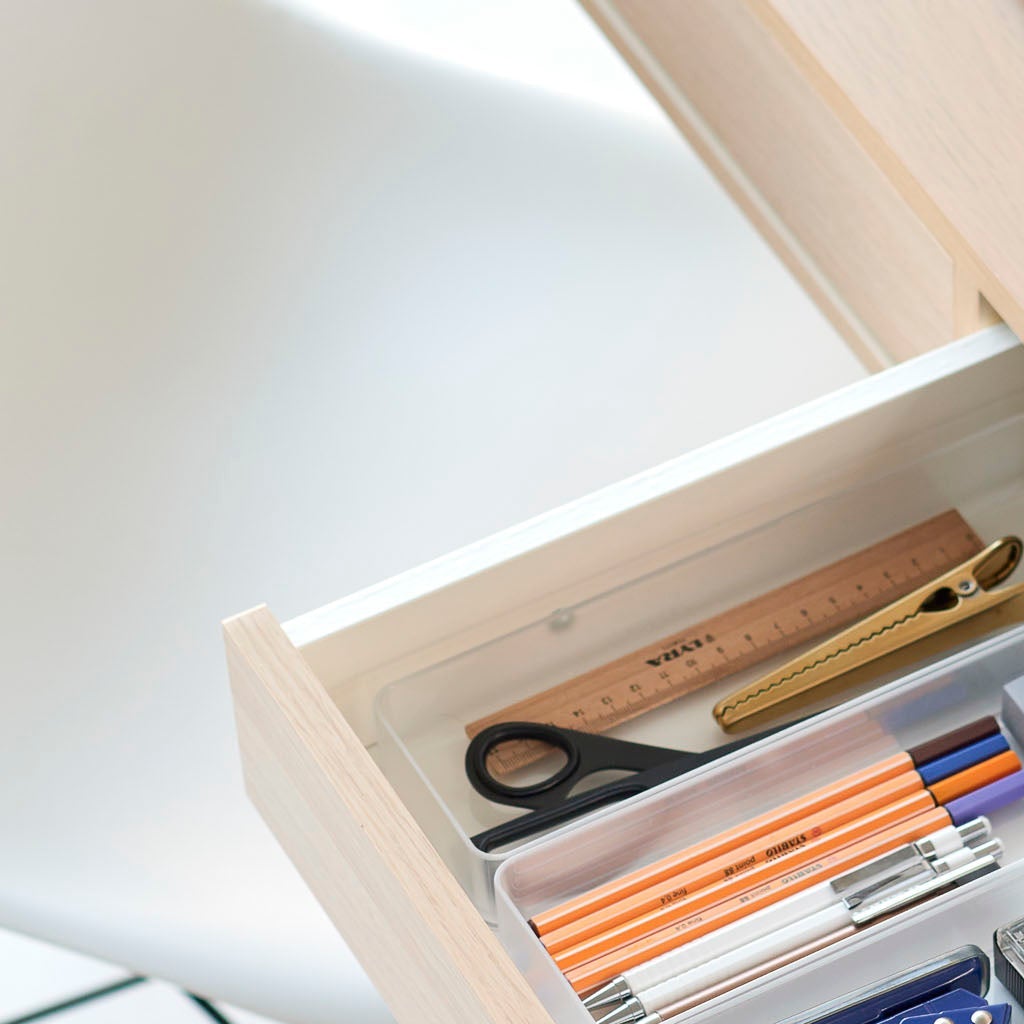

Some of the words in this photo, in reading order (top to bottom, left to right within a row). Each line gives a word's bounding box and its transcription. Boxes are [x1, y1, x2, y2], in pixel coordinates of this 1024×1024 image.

[645, 638, 704, 668] LYRA
[765, 833, 807, 858] STABILO
[735, 855, 756, 872] point
[723, 867, 735, 878] 88
[671, 888, 688, 899] fine
